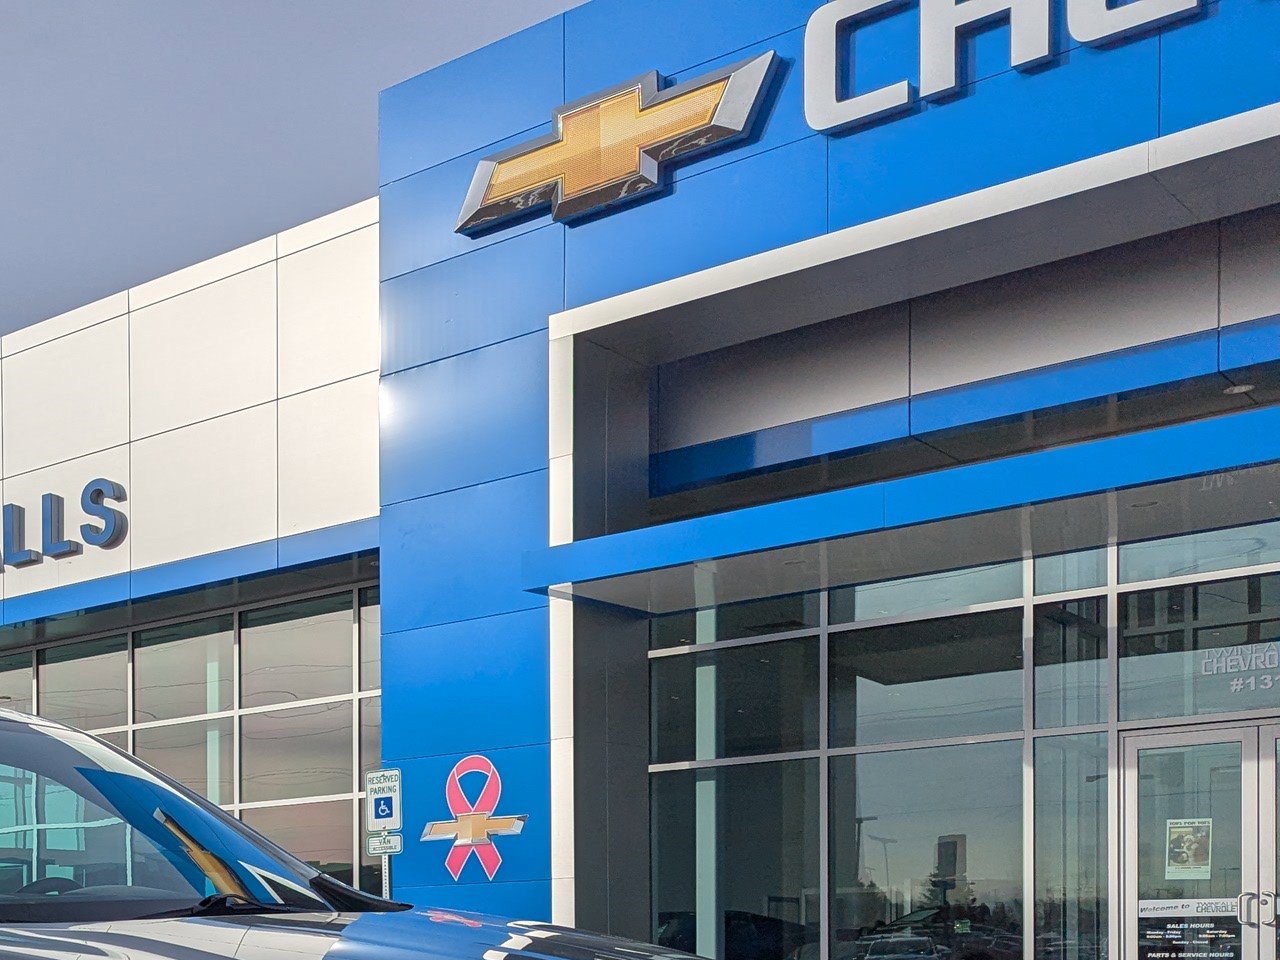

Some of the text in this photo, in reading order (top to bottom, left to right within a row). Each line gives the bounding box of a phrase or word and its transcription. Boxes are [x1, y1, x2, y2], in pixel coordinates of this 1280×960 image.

[804, 0, 1200, 131] CH
[368, 774, 398, 784] RESERVED
[370, 785, 396, 795] PARKING
[1140, 904, 1178, 913] Welcome
